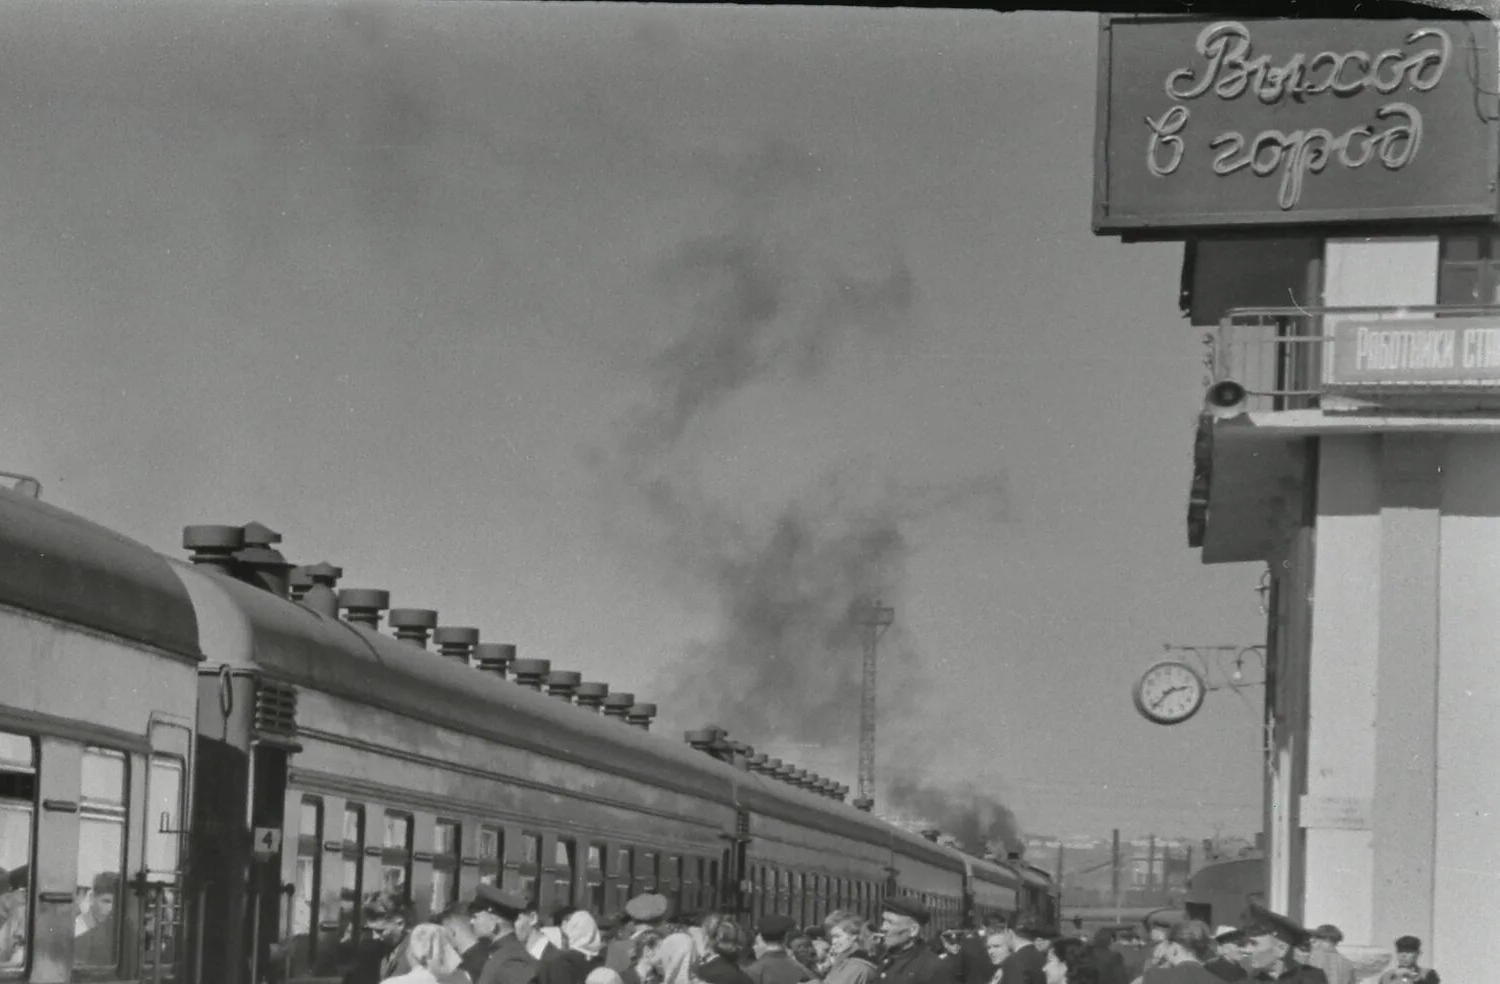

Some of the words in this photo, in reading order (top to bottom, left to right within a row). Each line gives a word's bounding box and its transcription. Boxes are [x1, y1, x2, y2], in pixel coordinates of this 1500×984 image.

[1165, 21, 1451, 101] Выход
[1145, 106, 1190, 175] в
[1209, 103, 1423, 210] город
[262, 830, 273, 849] 4
